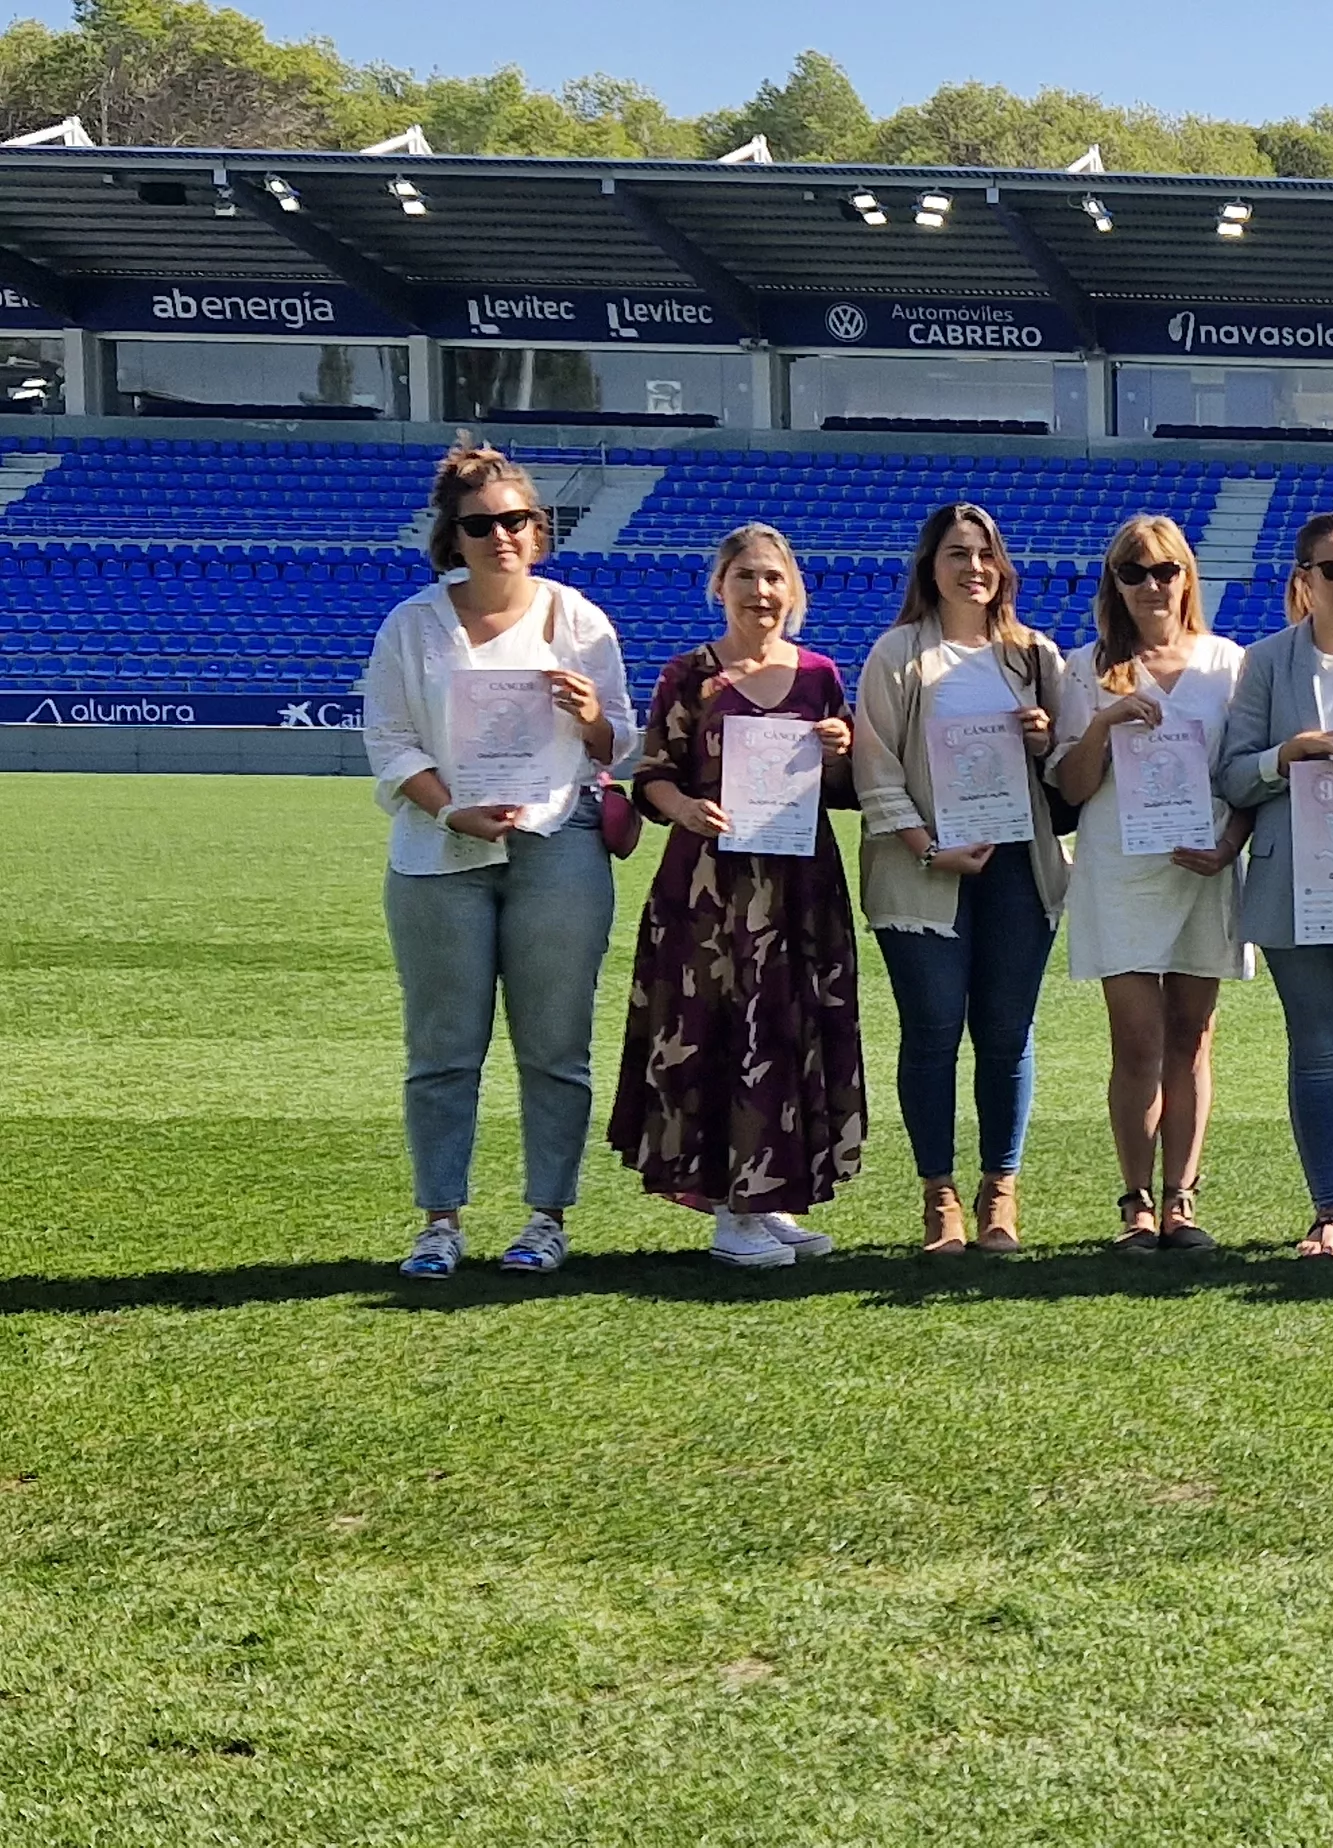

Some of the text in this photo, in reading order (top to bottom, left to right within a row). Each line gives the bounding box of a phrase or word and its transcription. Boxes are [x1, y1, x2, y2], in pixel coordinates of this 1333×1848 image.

[891, 303, 1015, 323] Automóviles
[908, 323, 1043, 347] CABRERO
[70, 697, 196, 722] alumbra
[317, 702, 362, 728] Cai
